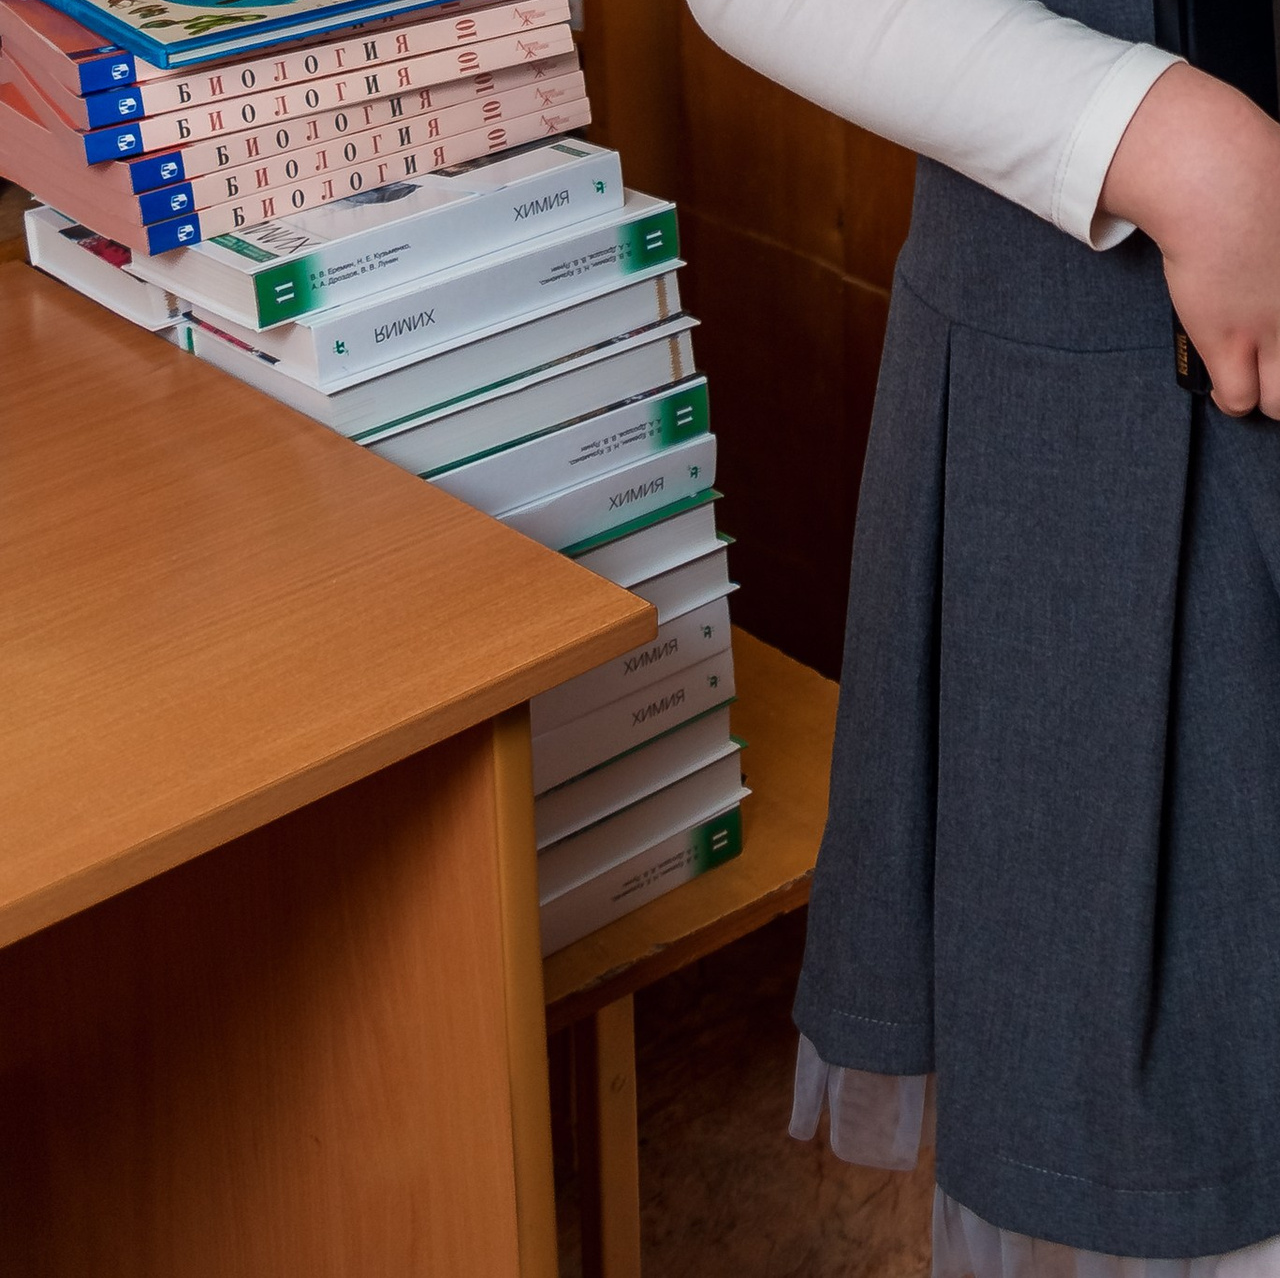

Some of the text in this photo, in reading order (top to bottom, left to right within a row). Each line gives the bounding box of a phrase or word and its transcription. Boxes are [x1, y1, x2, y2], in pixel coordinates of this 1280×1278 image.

[176, 33, 408, 105] БИОЛОГИЯ
[176, 66, 413, 140] БИОЛОГИЯ
[215, 89, 433, 167] БИОЛОГИЯ
[225, 117, 442, 197] БИОЛОГИЯ
[232, 145, 447, 228] БИОЛОГИЯ
[513, 189, 570, 221] ХИМИЯ
[374, 307, 436, 344] ХИМИЯ
[608, 477, 664, 512] ХИМИЯ
[624, 638, 678, 676] ХИМИЯ
[632, 688, 686, 727] ХИМИЯ
